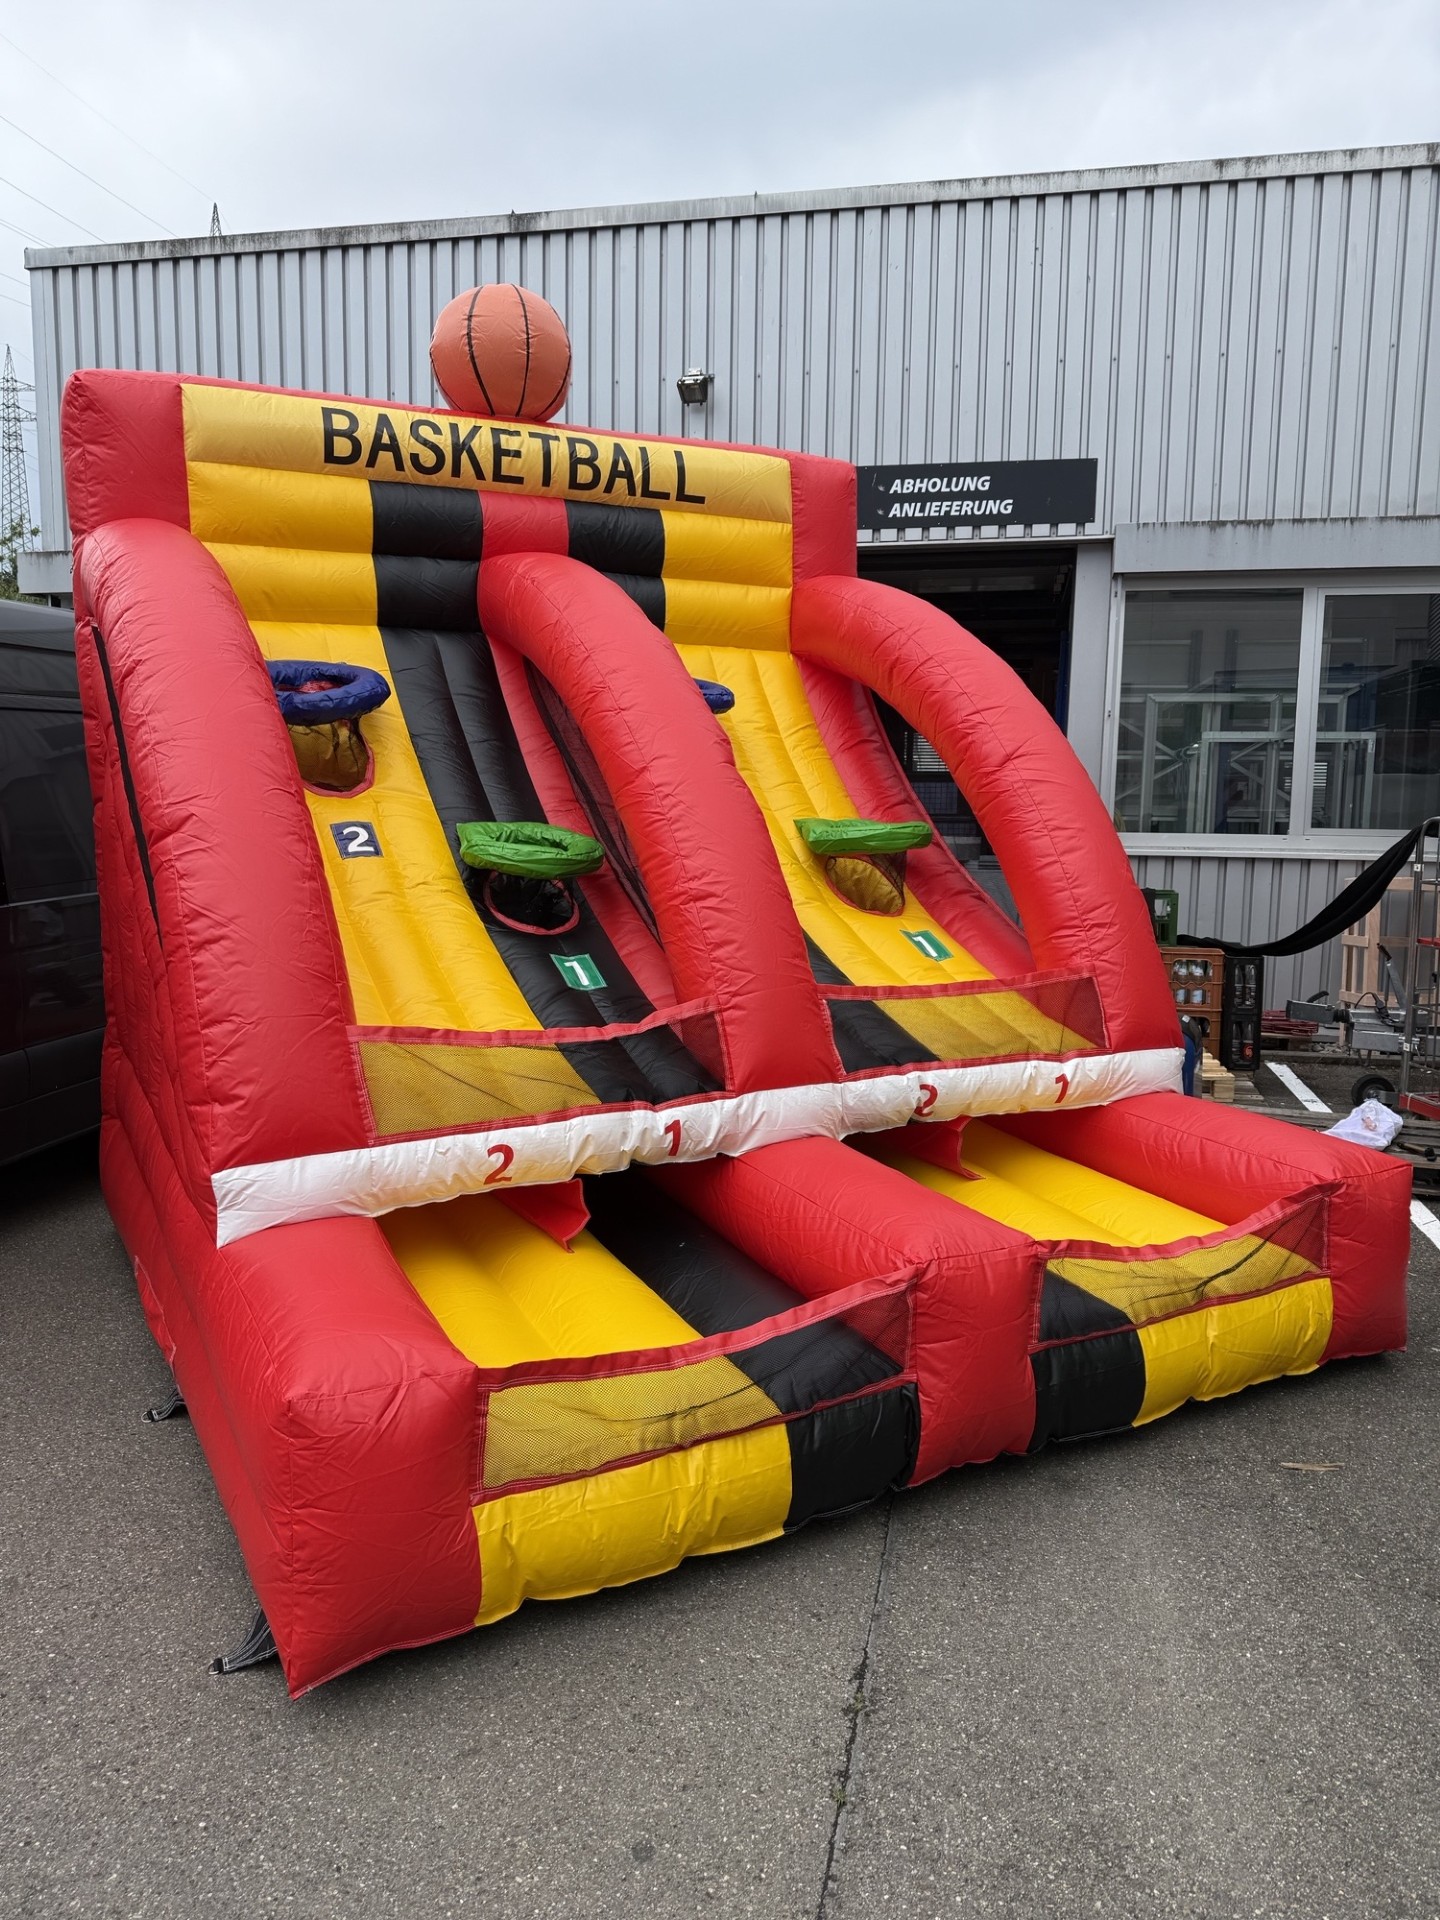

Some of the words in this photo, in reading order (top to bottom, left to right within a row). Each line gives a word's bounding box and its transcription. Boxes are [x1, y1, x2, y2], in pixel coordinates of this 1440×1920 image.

[321, 406, 706, 505] BASKETBALL
[888, 475, 991, 494] ABHOLUNG
[888, 499, 1014, 518] ANLIEFERUNG
[342, 826, 375, 853] 2
[911, 935, 939, 958] 1
[563, 960, 590, 986] 1
[914, 1083, 938, 1117] 2
[1054, 1073, 1070, 1104] 1
[483, 1143, 515, 1185] 2
[663, 1118, 682, 1157] 1
